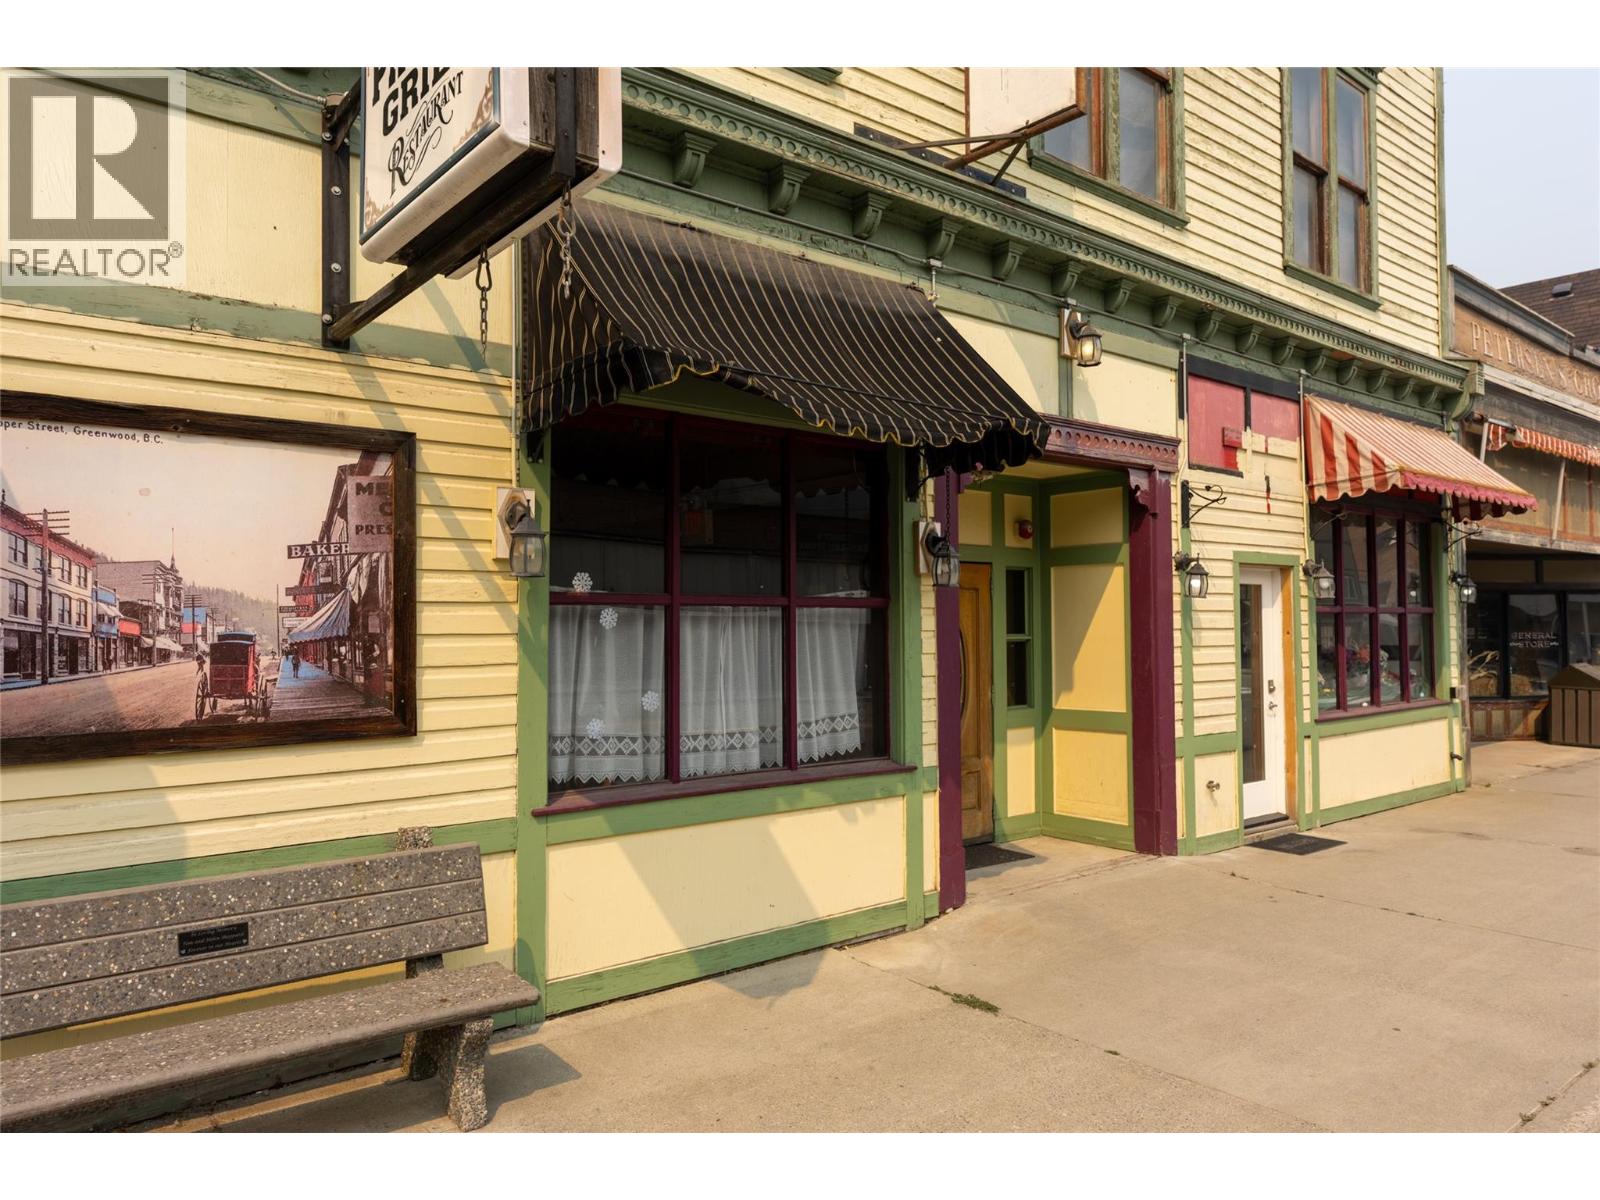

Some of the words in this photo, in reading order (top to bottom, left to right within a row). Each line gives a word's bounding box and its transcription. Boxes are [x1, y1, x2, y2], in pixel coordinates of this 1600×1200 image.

[27, 421, 68, 435] Street,
[73, 425, 141, 443] Greenwood,
[1511, 631, 1557, 640] GENERAL
[1519, 640, 1551, 648] STORE
